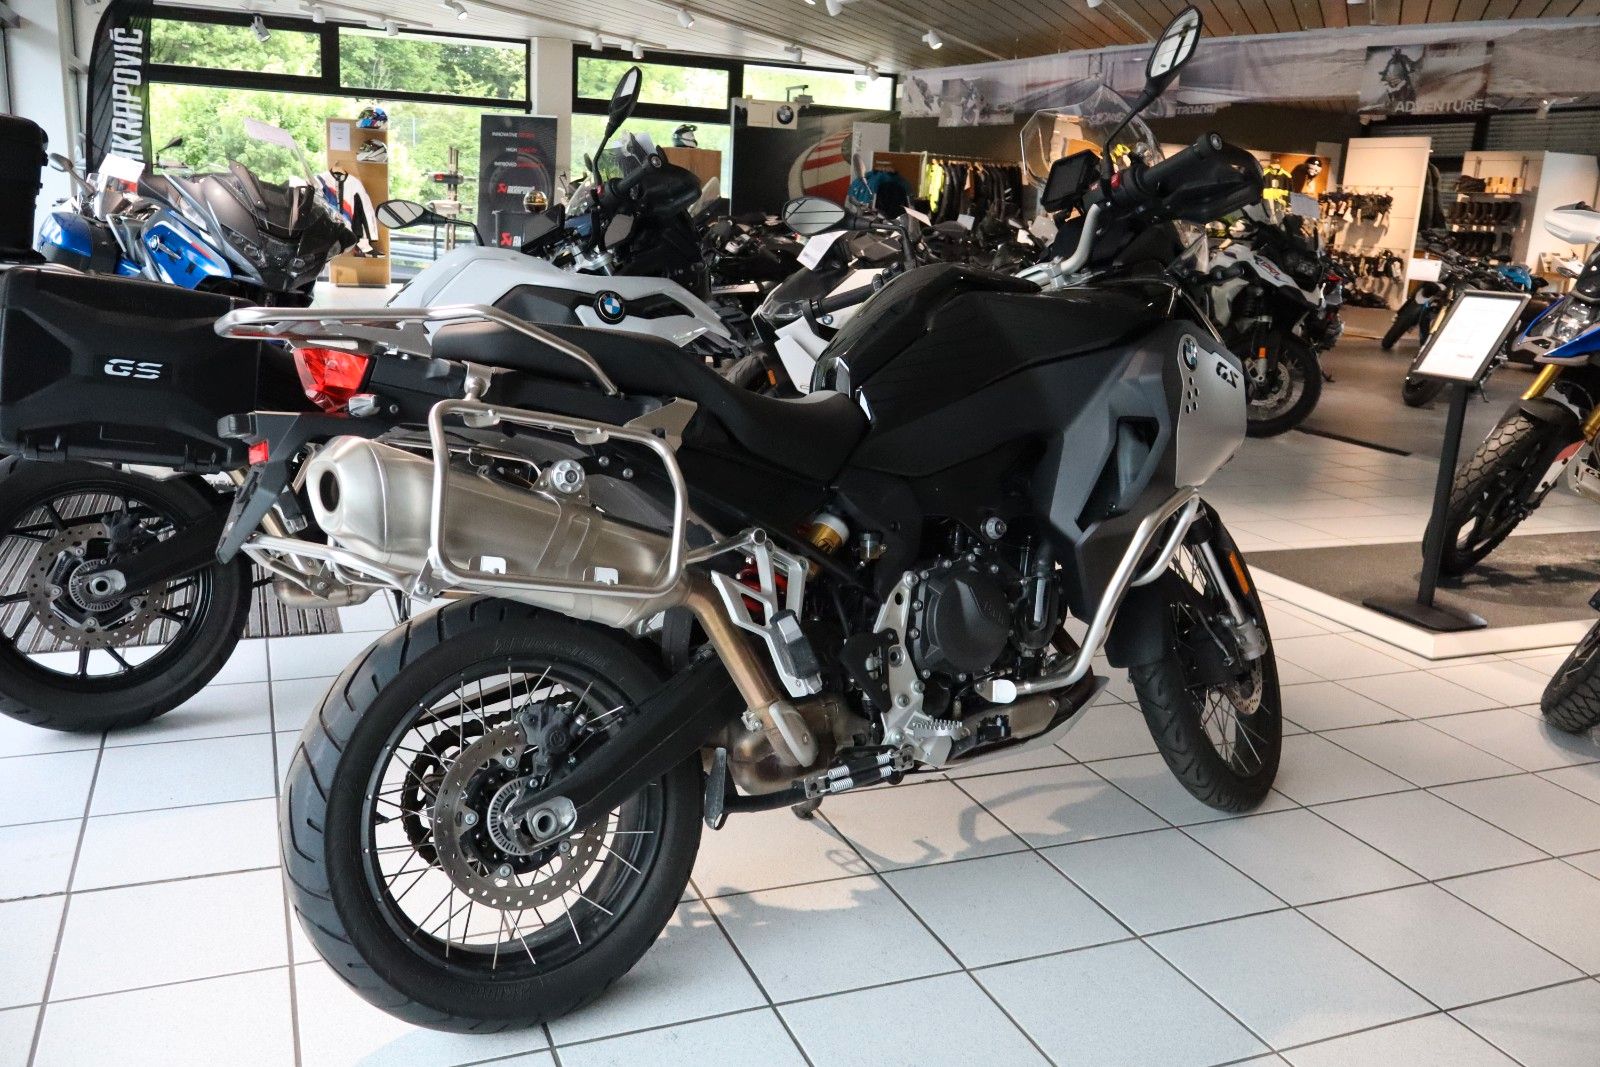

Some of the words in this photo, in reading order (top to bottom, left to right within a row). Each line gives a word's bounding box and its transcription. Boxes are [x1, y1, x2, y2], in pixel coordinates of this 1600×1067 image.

[1395, 99, 1484, 113] ADVENTURE
[104, 358, 163, 380] GS
[1215, 361, 1239, 389] GS
